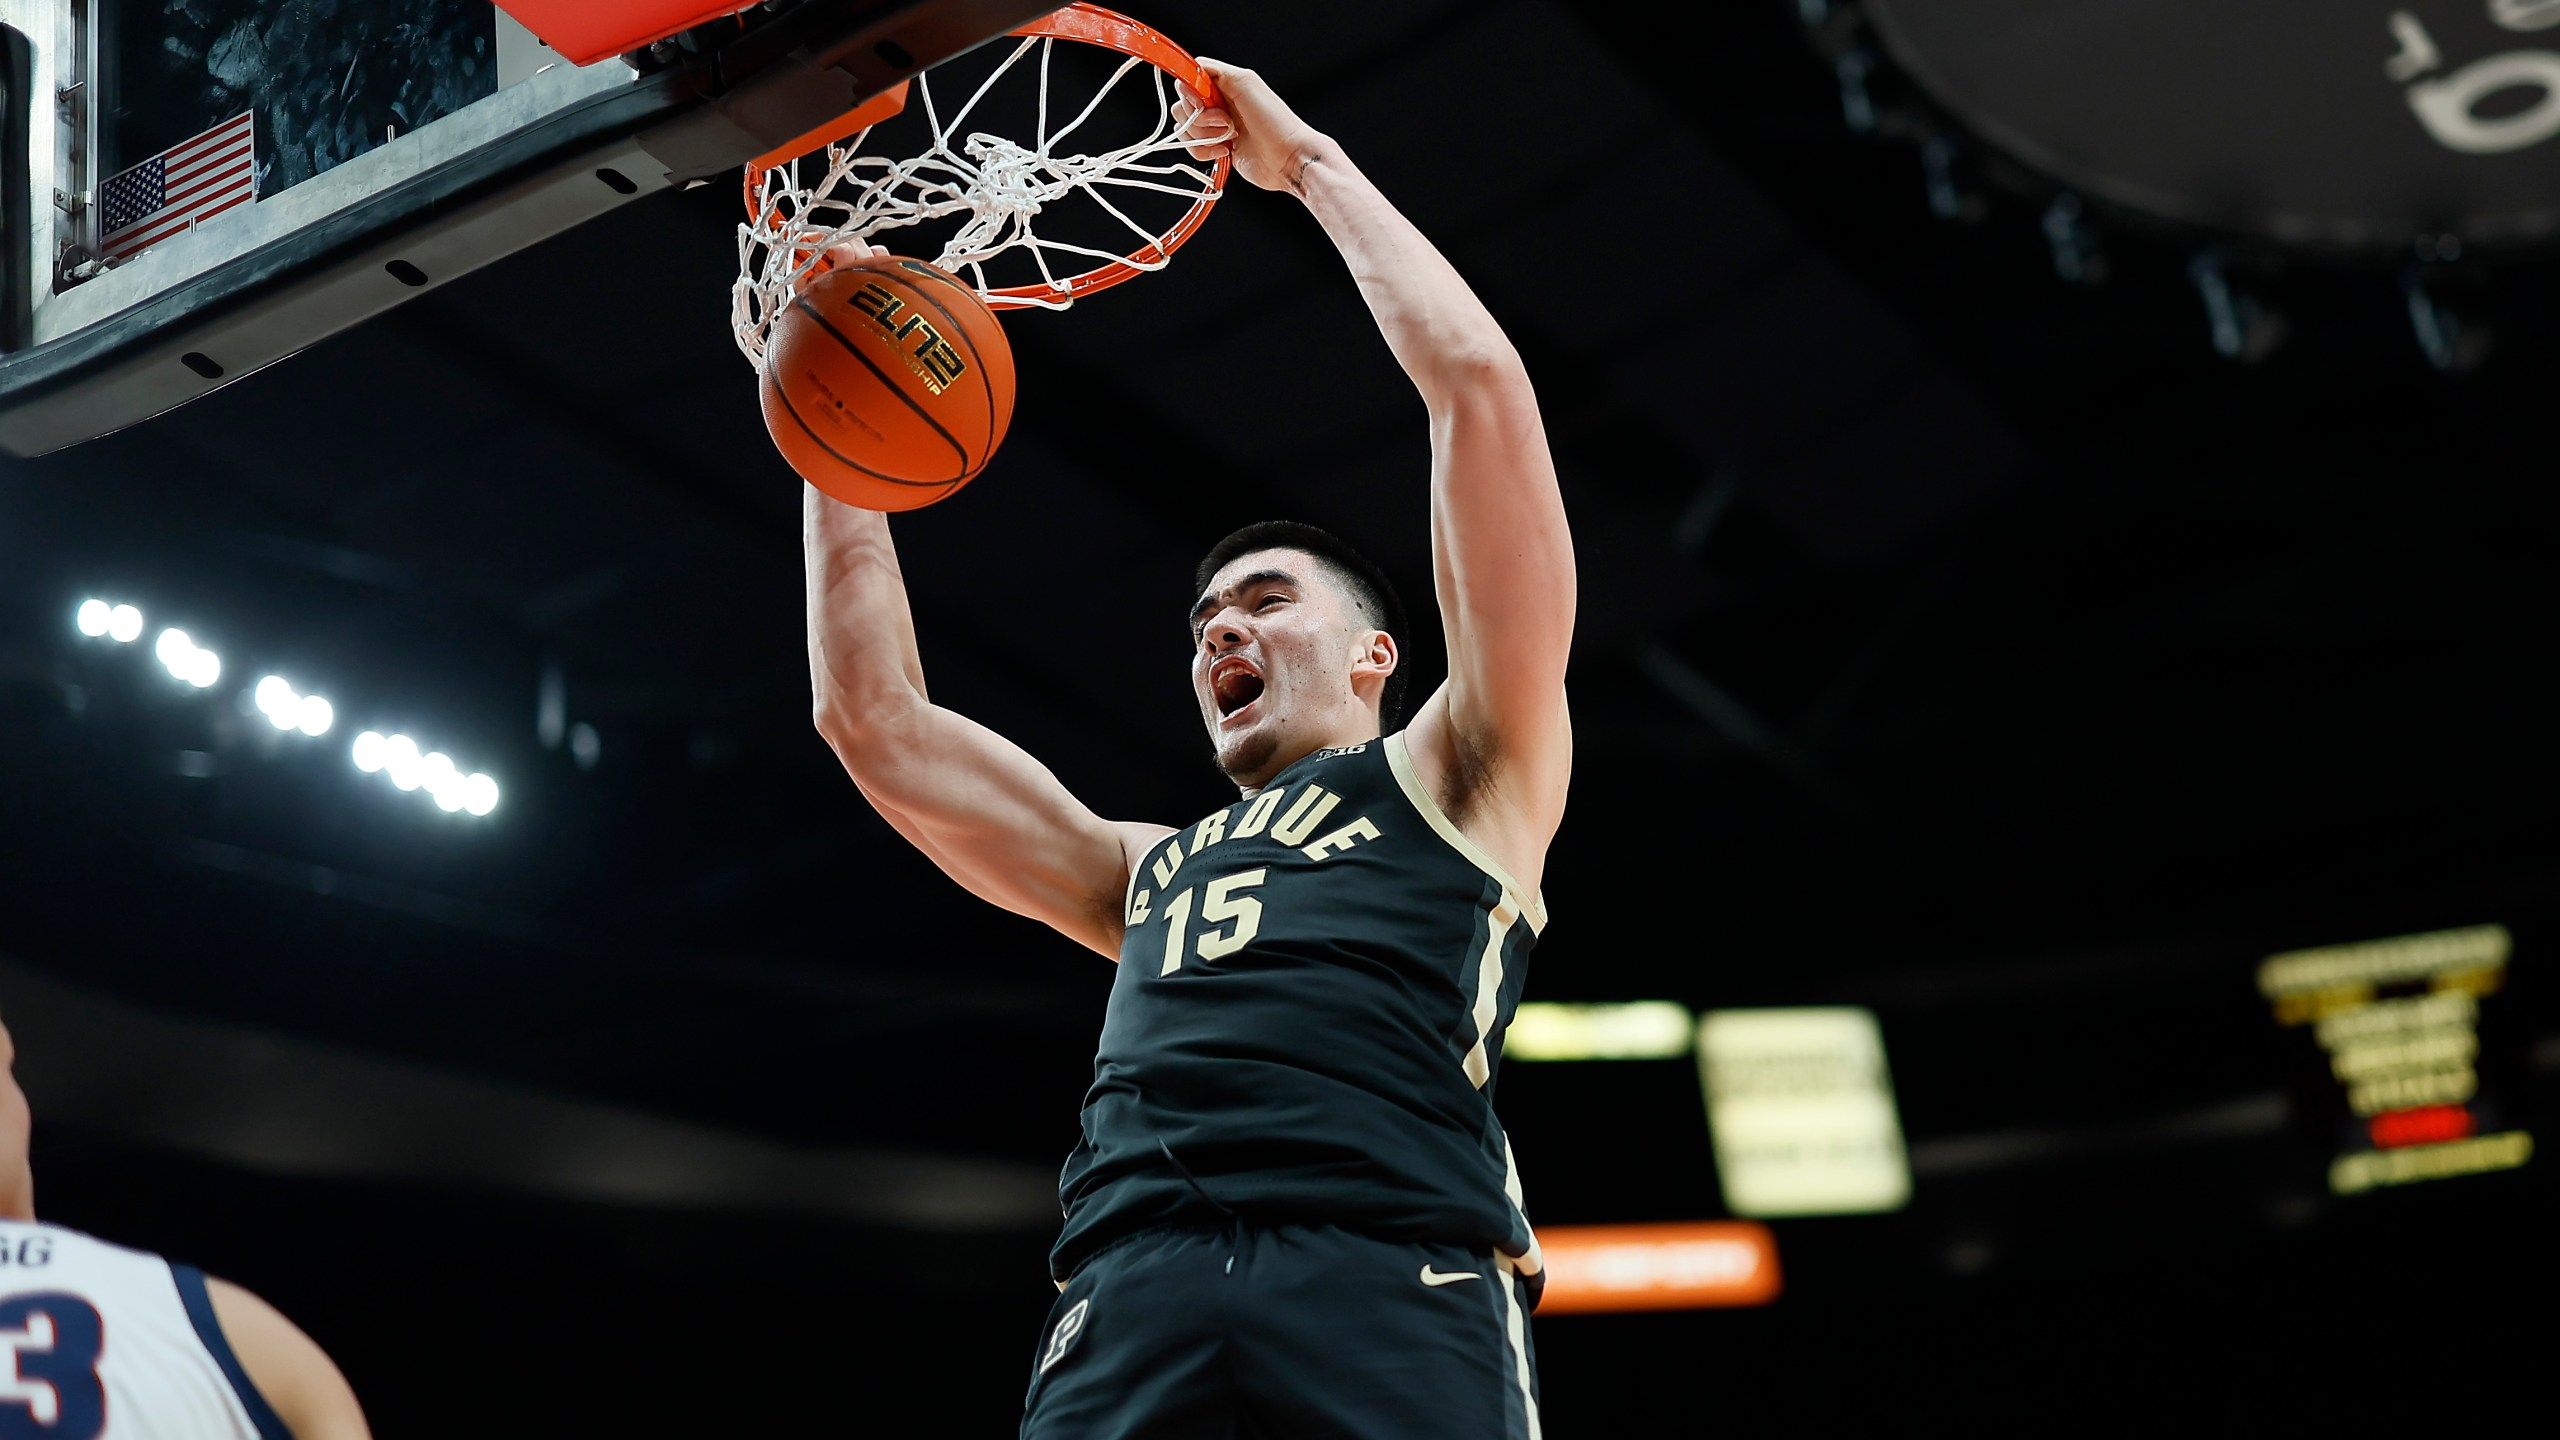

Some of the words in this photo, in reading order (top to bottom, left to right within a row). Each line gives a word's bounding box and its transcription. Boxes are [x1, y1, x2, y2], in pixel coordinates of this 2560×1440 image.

[847, 282, 967, 390] ELITE
[1128, 782, 1383, 927] PURDUE
[1159, 867, 1270, 978] 15
[1040, 1299, 1089, 1374] P
